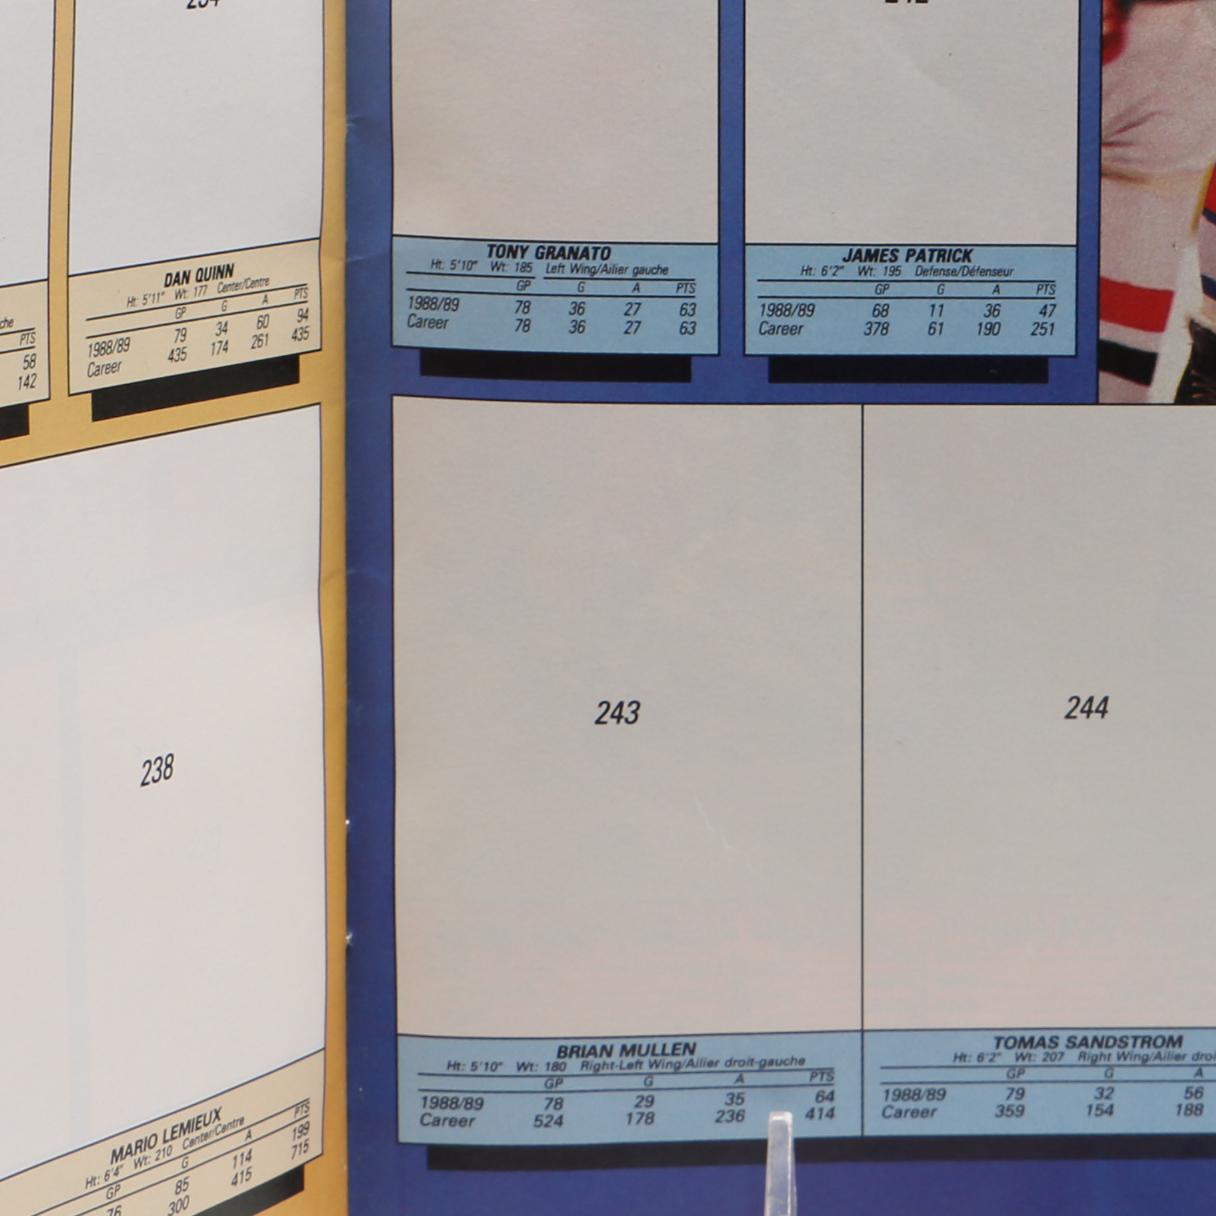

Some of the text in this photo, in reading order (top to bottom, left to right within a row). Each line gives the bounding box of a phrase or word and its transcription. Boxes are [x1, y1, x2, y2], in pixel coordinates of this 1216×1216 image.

[487, 244, 611, 261] TONY GRANATO
[843, 248, 974, 263] JAMES PATRICK
[164, 263, 235, 288] DAN QUINN
[760, 303, 1056, 317] 1988/89 68 11 36 47
[88, 308, 309, 358] 1988/89 79 34 60 94
[407, 313, 696, 335] Career 78 36 27 63
[595, 699, 640, 726] 243
[1065, 695, 1110, 720] 244
[140, 752, 175, 787] 238
[556, 1042, 696, 1059] BRIAN MULLEN
[994, 1035, 1183, 1050] TOMAS SANDSTROM
[421, 1090, 835, 1110] 1988/89 78 29 35 64
[882, 1105, 937, 1119] Career
[995, 1104, 1025, 1118] 359
[1086, 1104, 1114, 1117] 154
[1176, 1104, 1204, 1117] 188
[110, 1106, 222, 1164] MARIO LEMIEUX
